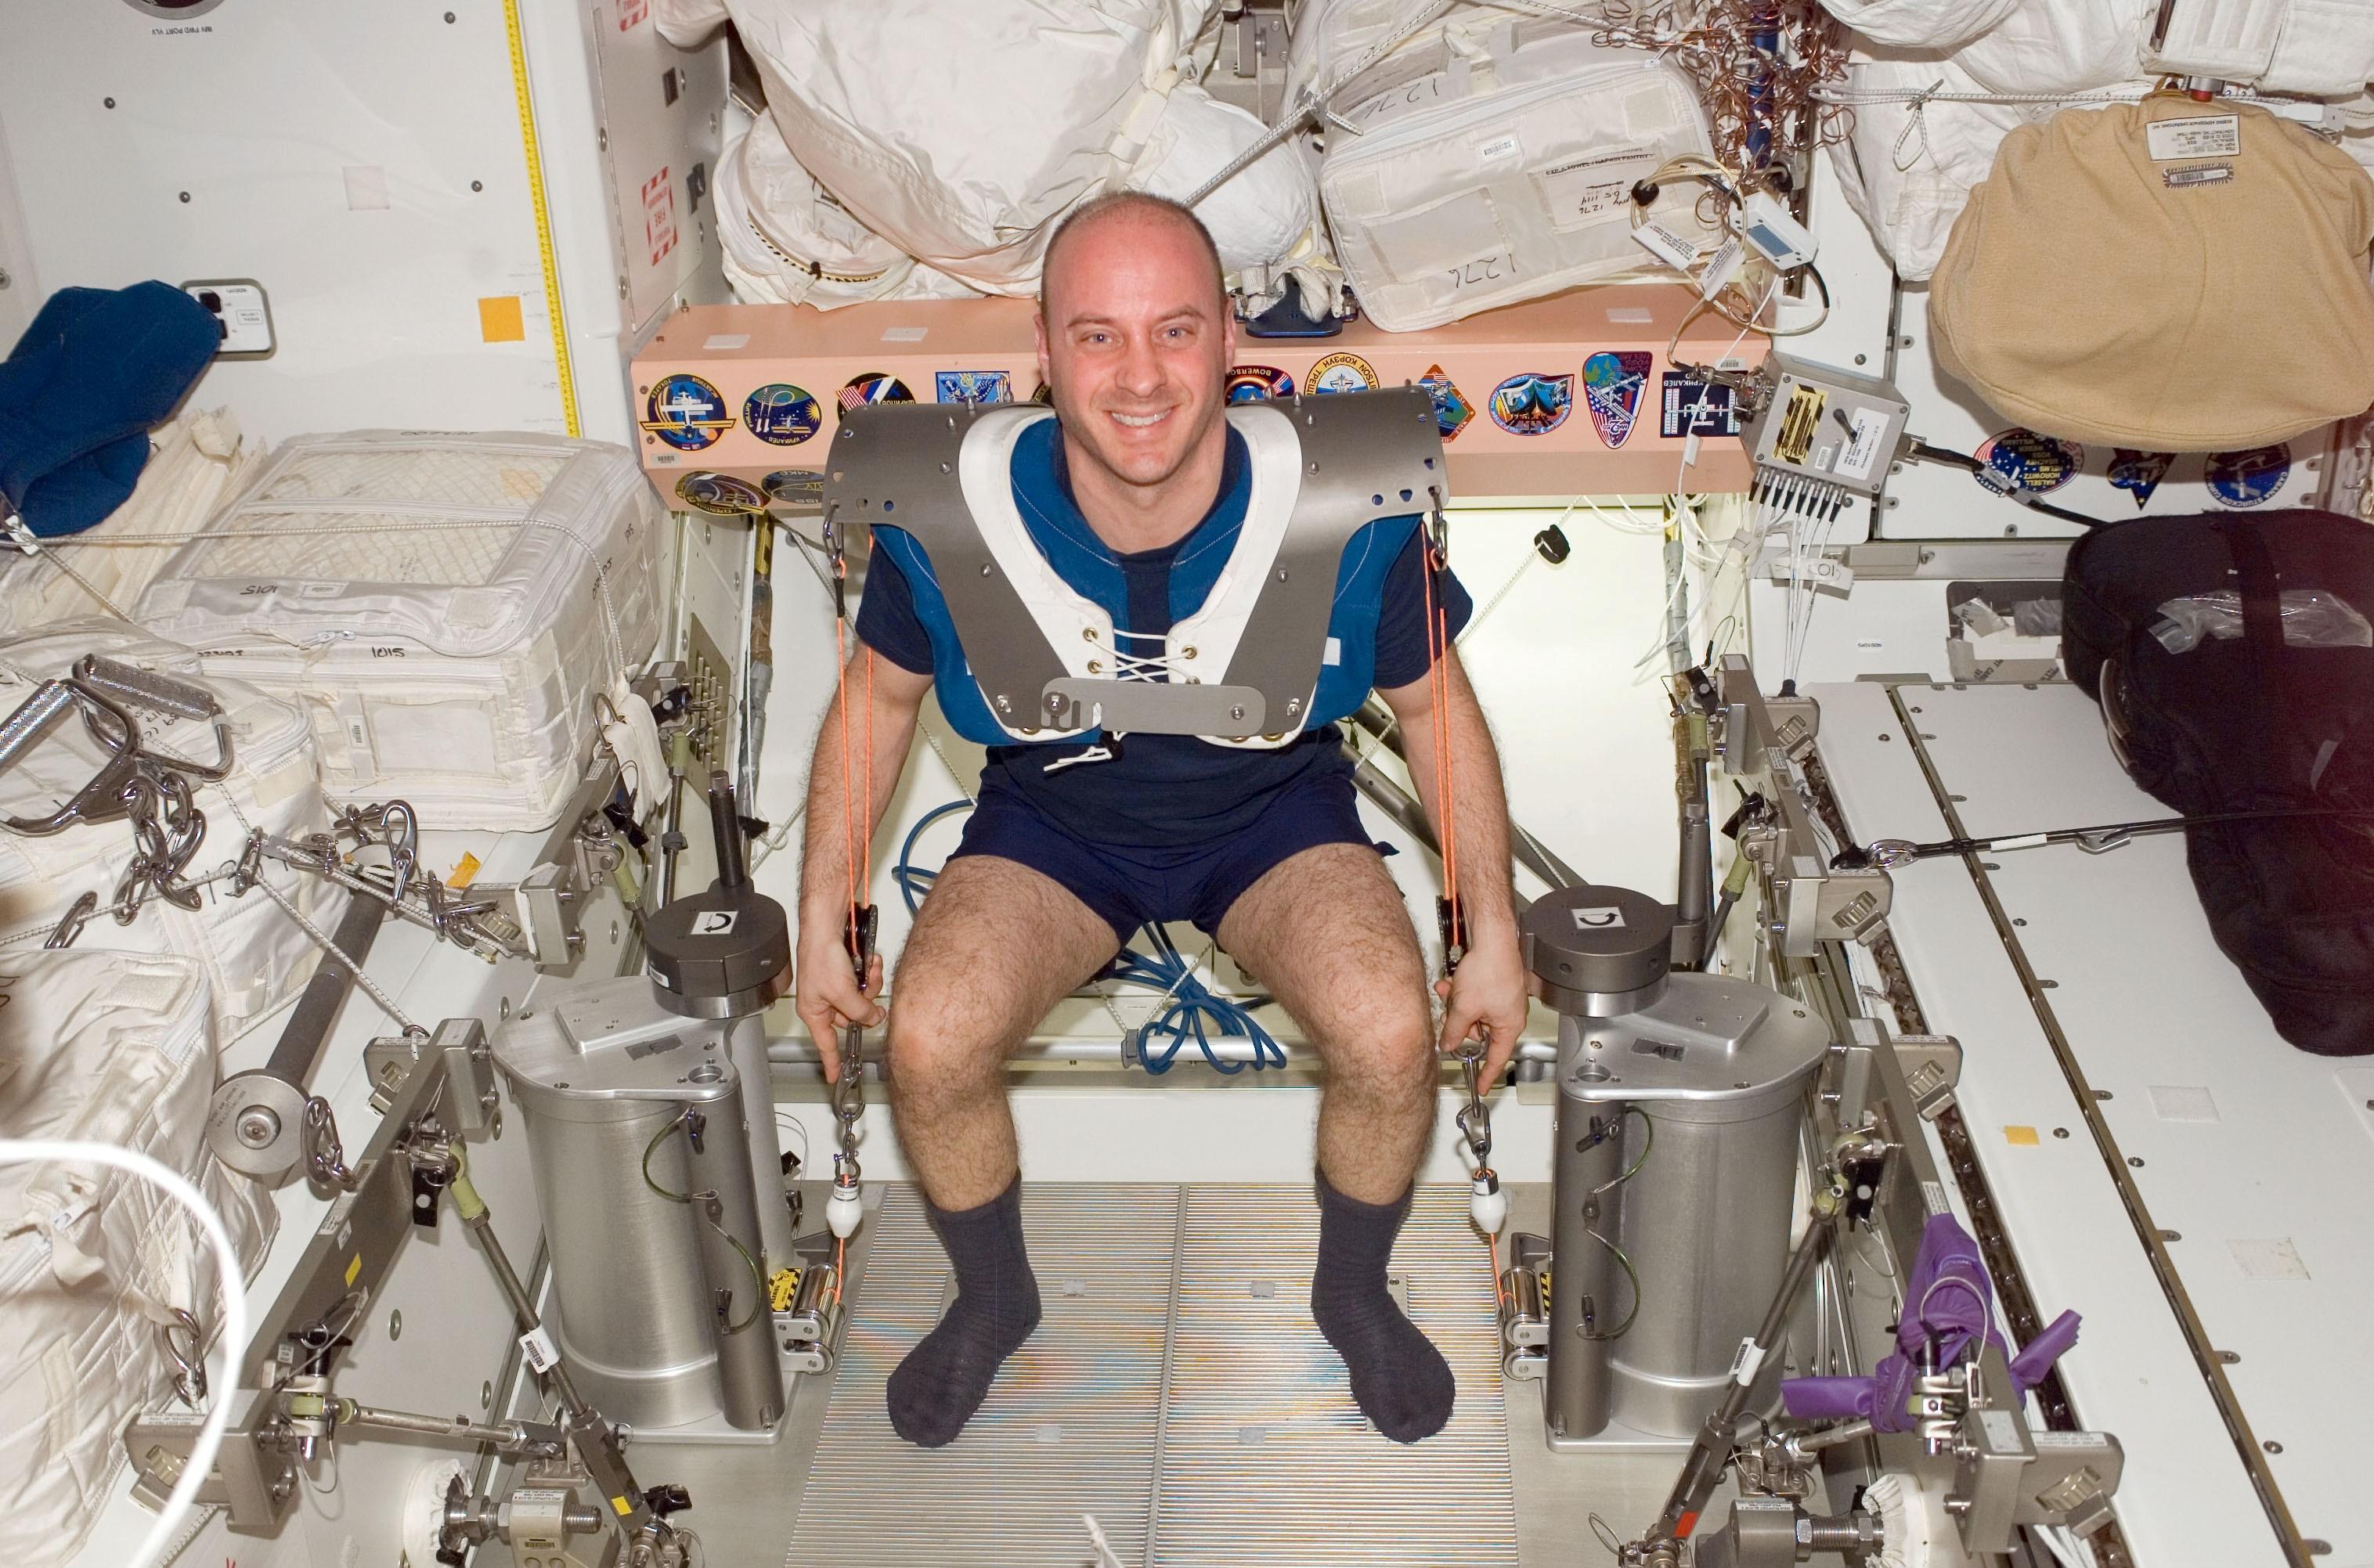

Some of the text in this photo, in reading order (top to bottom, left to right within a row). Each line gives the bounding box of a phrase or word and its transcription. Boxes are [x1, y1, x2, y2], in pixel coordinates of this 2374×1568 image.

[1578, 204, 1604, 214] 1276
[1448, 253, 1517, 289] 1276
[1322, 356, 1358, 368] КОРЗУН
[1229, 368, 1272, 377] BOWERSO
[1359, 365, 1377, 390] ITSON
[755, 418, 770, 433] 11
[2221, 496, 2264, 507] STURCKOW
[240, 586, 278, 595] 1015
[371, 646, 406, 658] 1015
[1653, 1045, 1683, 1061] AFT
